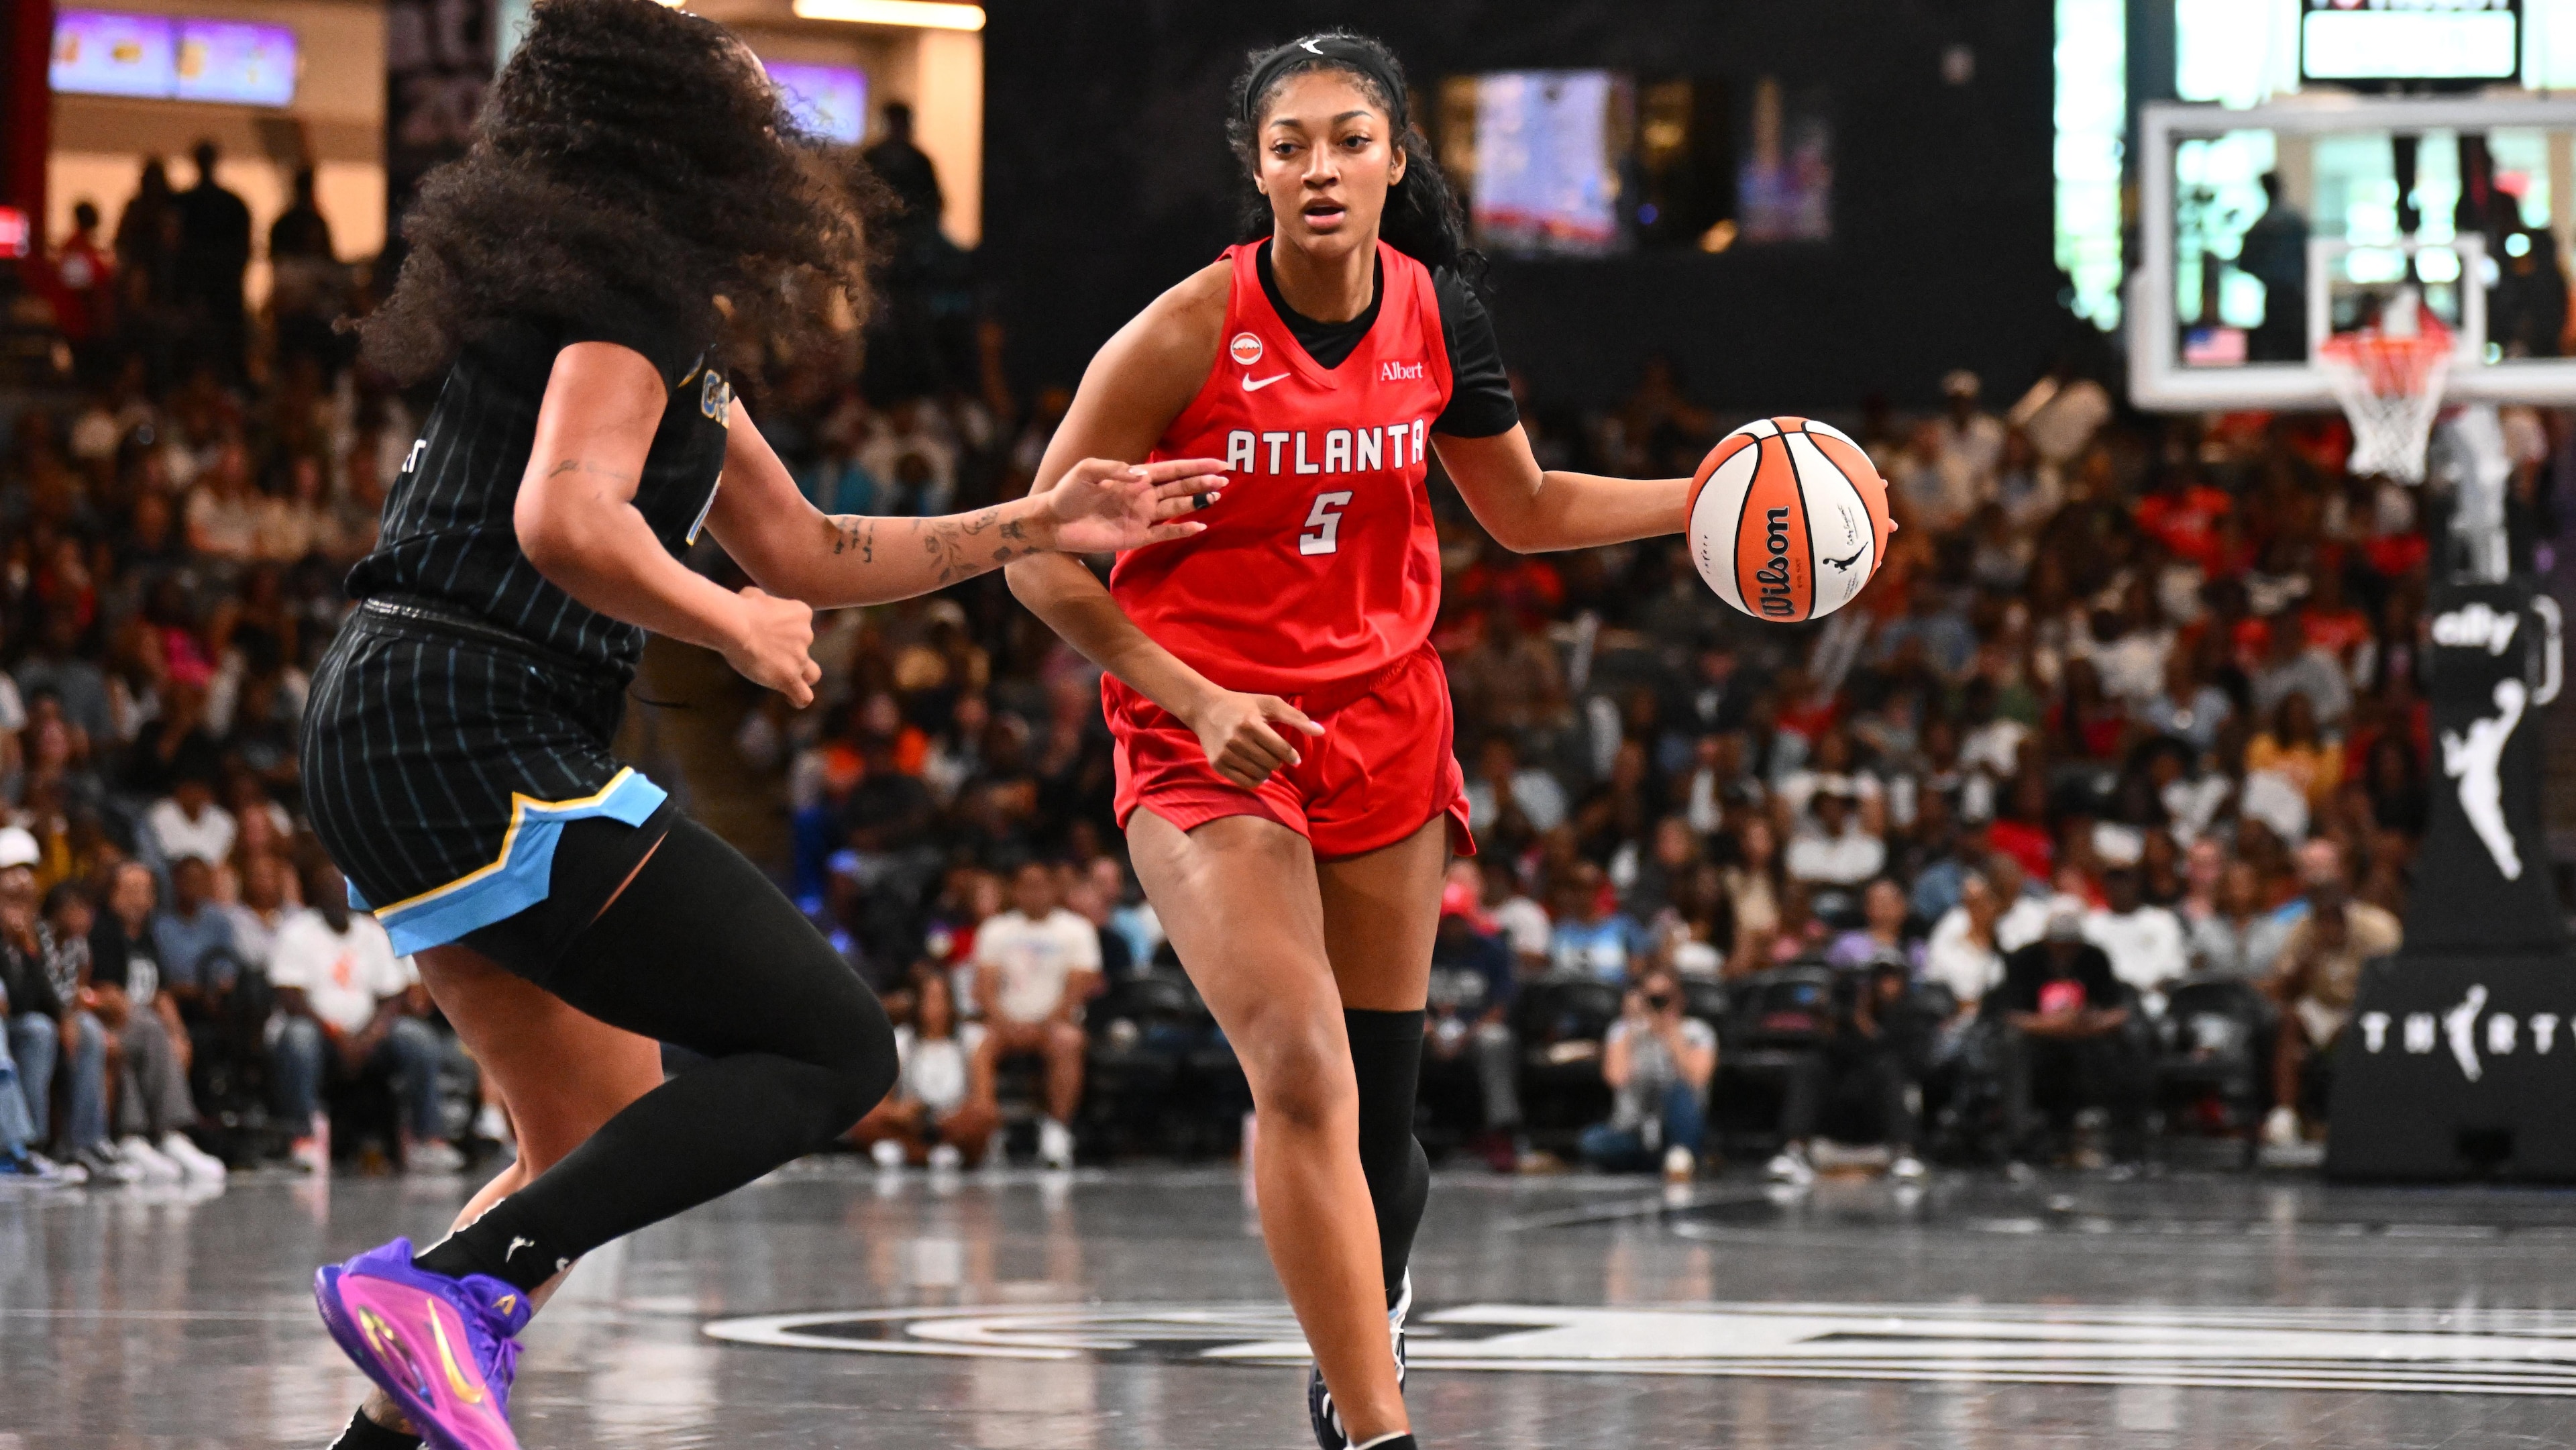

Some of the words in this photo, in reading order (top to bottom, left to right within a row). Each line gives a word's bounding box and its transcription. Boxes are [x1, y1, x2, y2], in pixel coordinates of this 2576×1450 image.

[1381, 361, 1423, 381] Albert
[1227, 417, 1424, 475] ATLANTA
[1299, 490, 1353, 556] 5
[1756, 505, 1796, 617] Wilson
